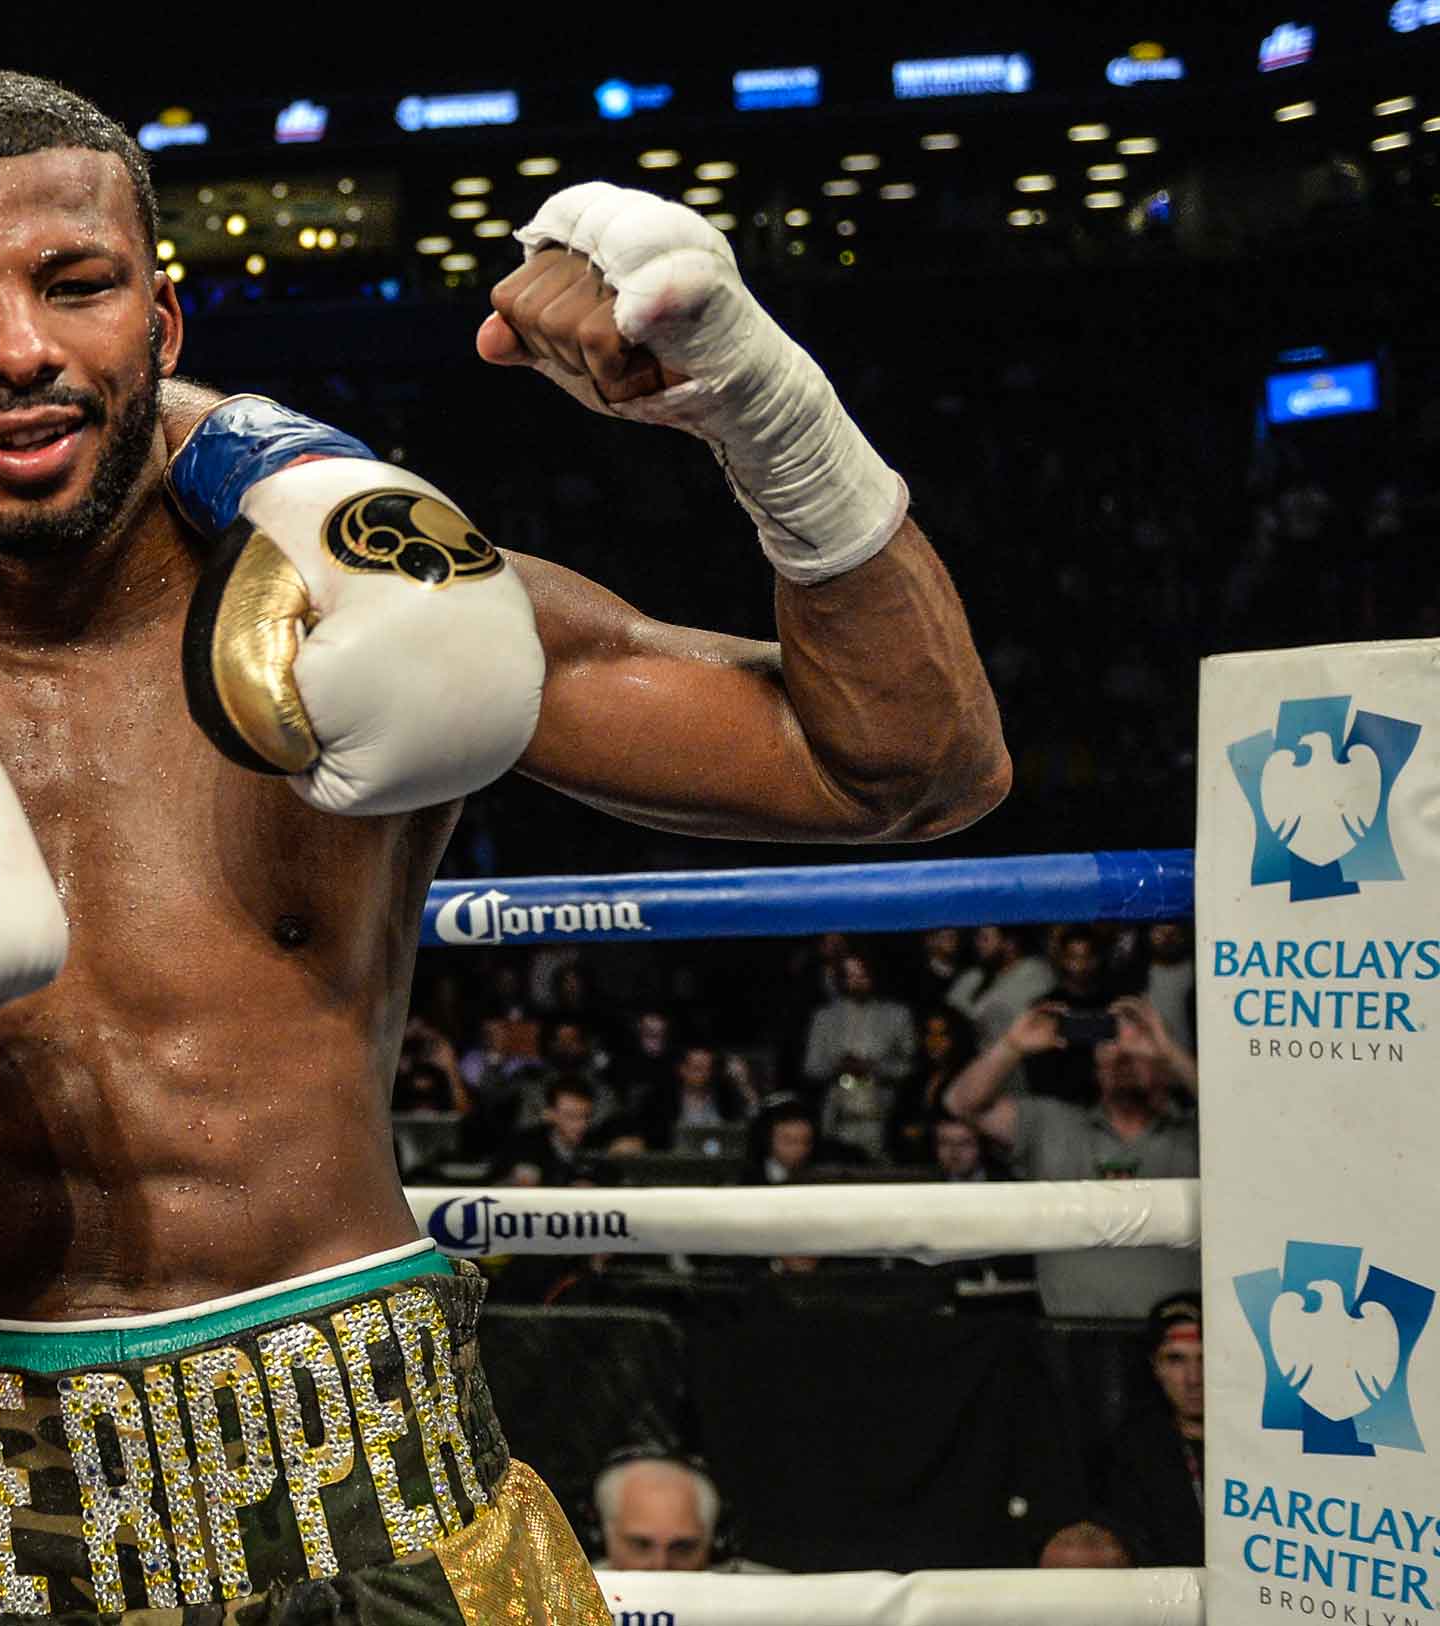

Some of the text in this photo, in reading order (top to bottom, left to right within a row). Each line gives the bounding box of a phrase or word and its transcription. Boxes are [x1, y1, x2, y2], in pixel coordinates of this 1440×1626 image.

[435, 889, 646, 944] Corona
[1214, 940, 1440, 980] BARCLAYS
[1234, 988, 1418, 1032] CENTER
[1249, 1039, 1404, 1062] BROOKLYN
[428, 1196, 630, 1255] Corona
[58, 1287, 489, 1614] RIPPER
[1223, 1478, 1440, 1557] BARCLAY
[1243, 1533, 1435, 1611] CENTER
